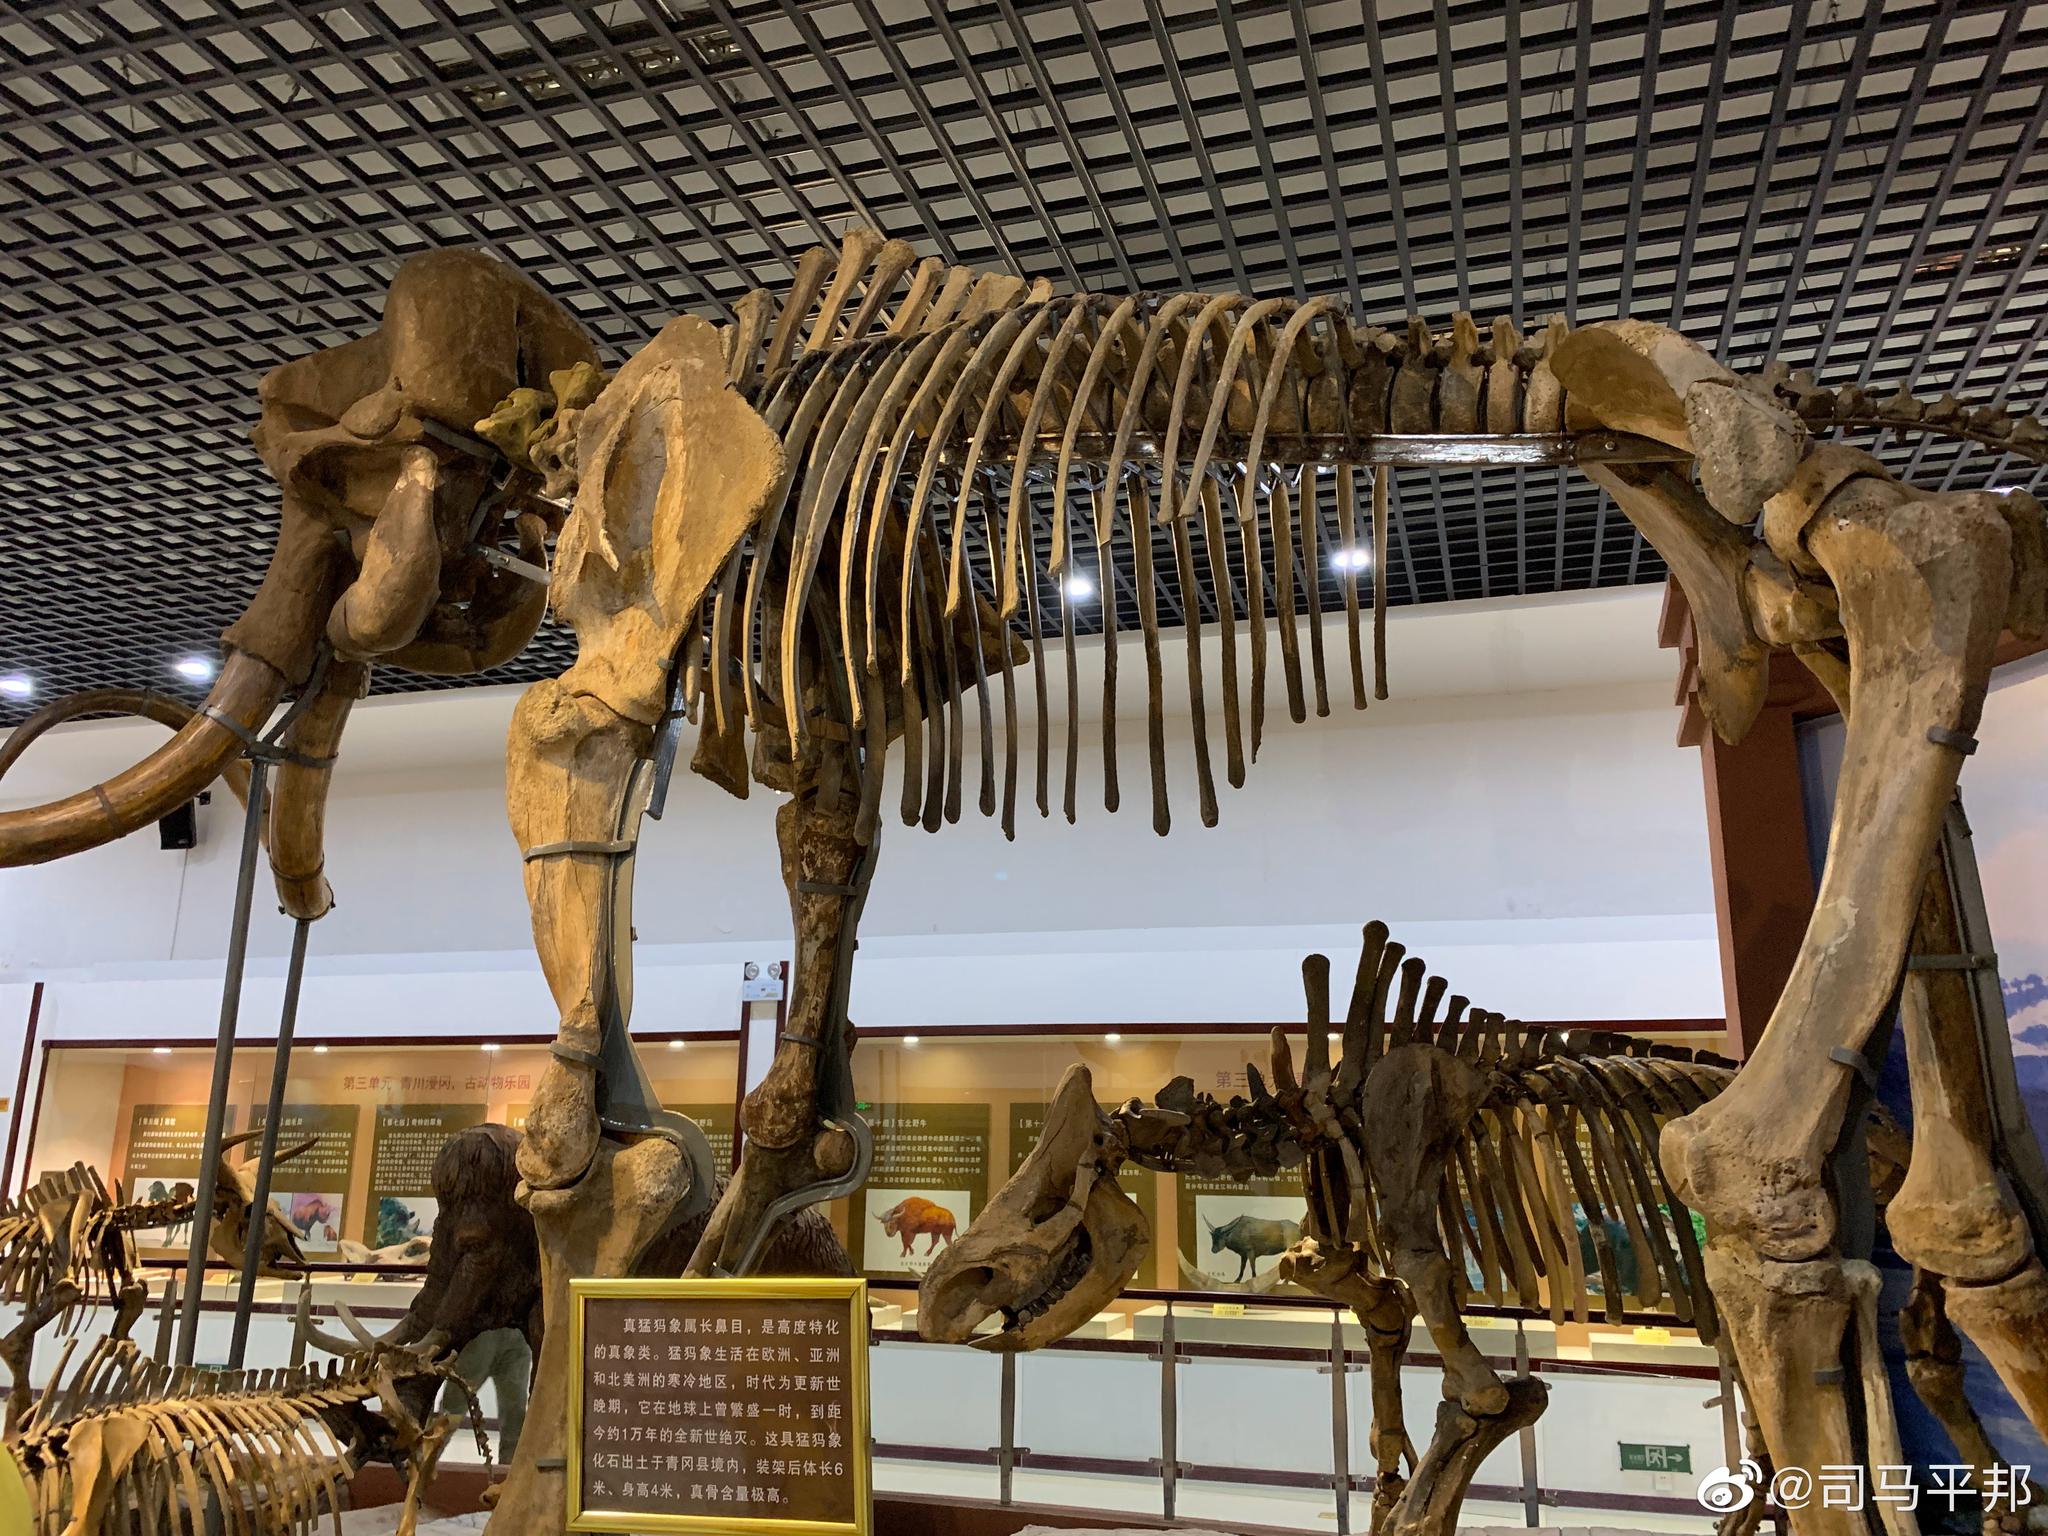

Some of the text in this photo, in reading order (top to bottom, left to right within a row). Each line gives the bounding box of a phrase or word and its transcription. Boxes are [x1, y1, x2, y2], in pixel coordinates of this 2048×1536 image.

[343, 1076, 392, 1090] 第三单元
[623, 1318, 840, 1336] 真猛犸象属长鼻目，是高度特化
[593, 1344, 841, 1363] 的真象类。猛犸象生活在欧洲、亚洲
[593, 1371, 842, 1392] 和北美洲的寒冷地区，时代为更新世
[592, 1399, 842, 1420] 晚期，它在地球上曾繁盛一时，到距
[592, 1426, 843, 1448] 今约1万年的全新世绝灭。这具猛犸象
[592, 1452, 844, 1476] 化石出土于青冈县境内，装架后体长6
[592, 1481, 791, 1504] 米、身高4米，真骨含量极高。
